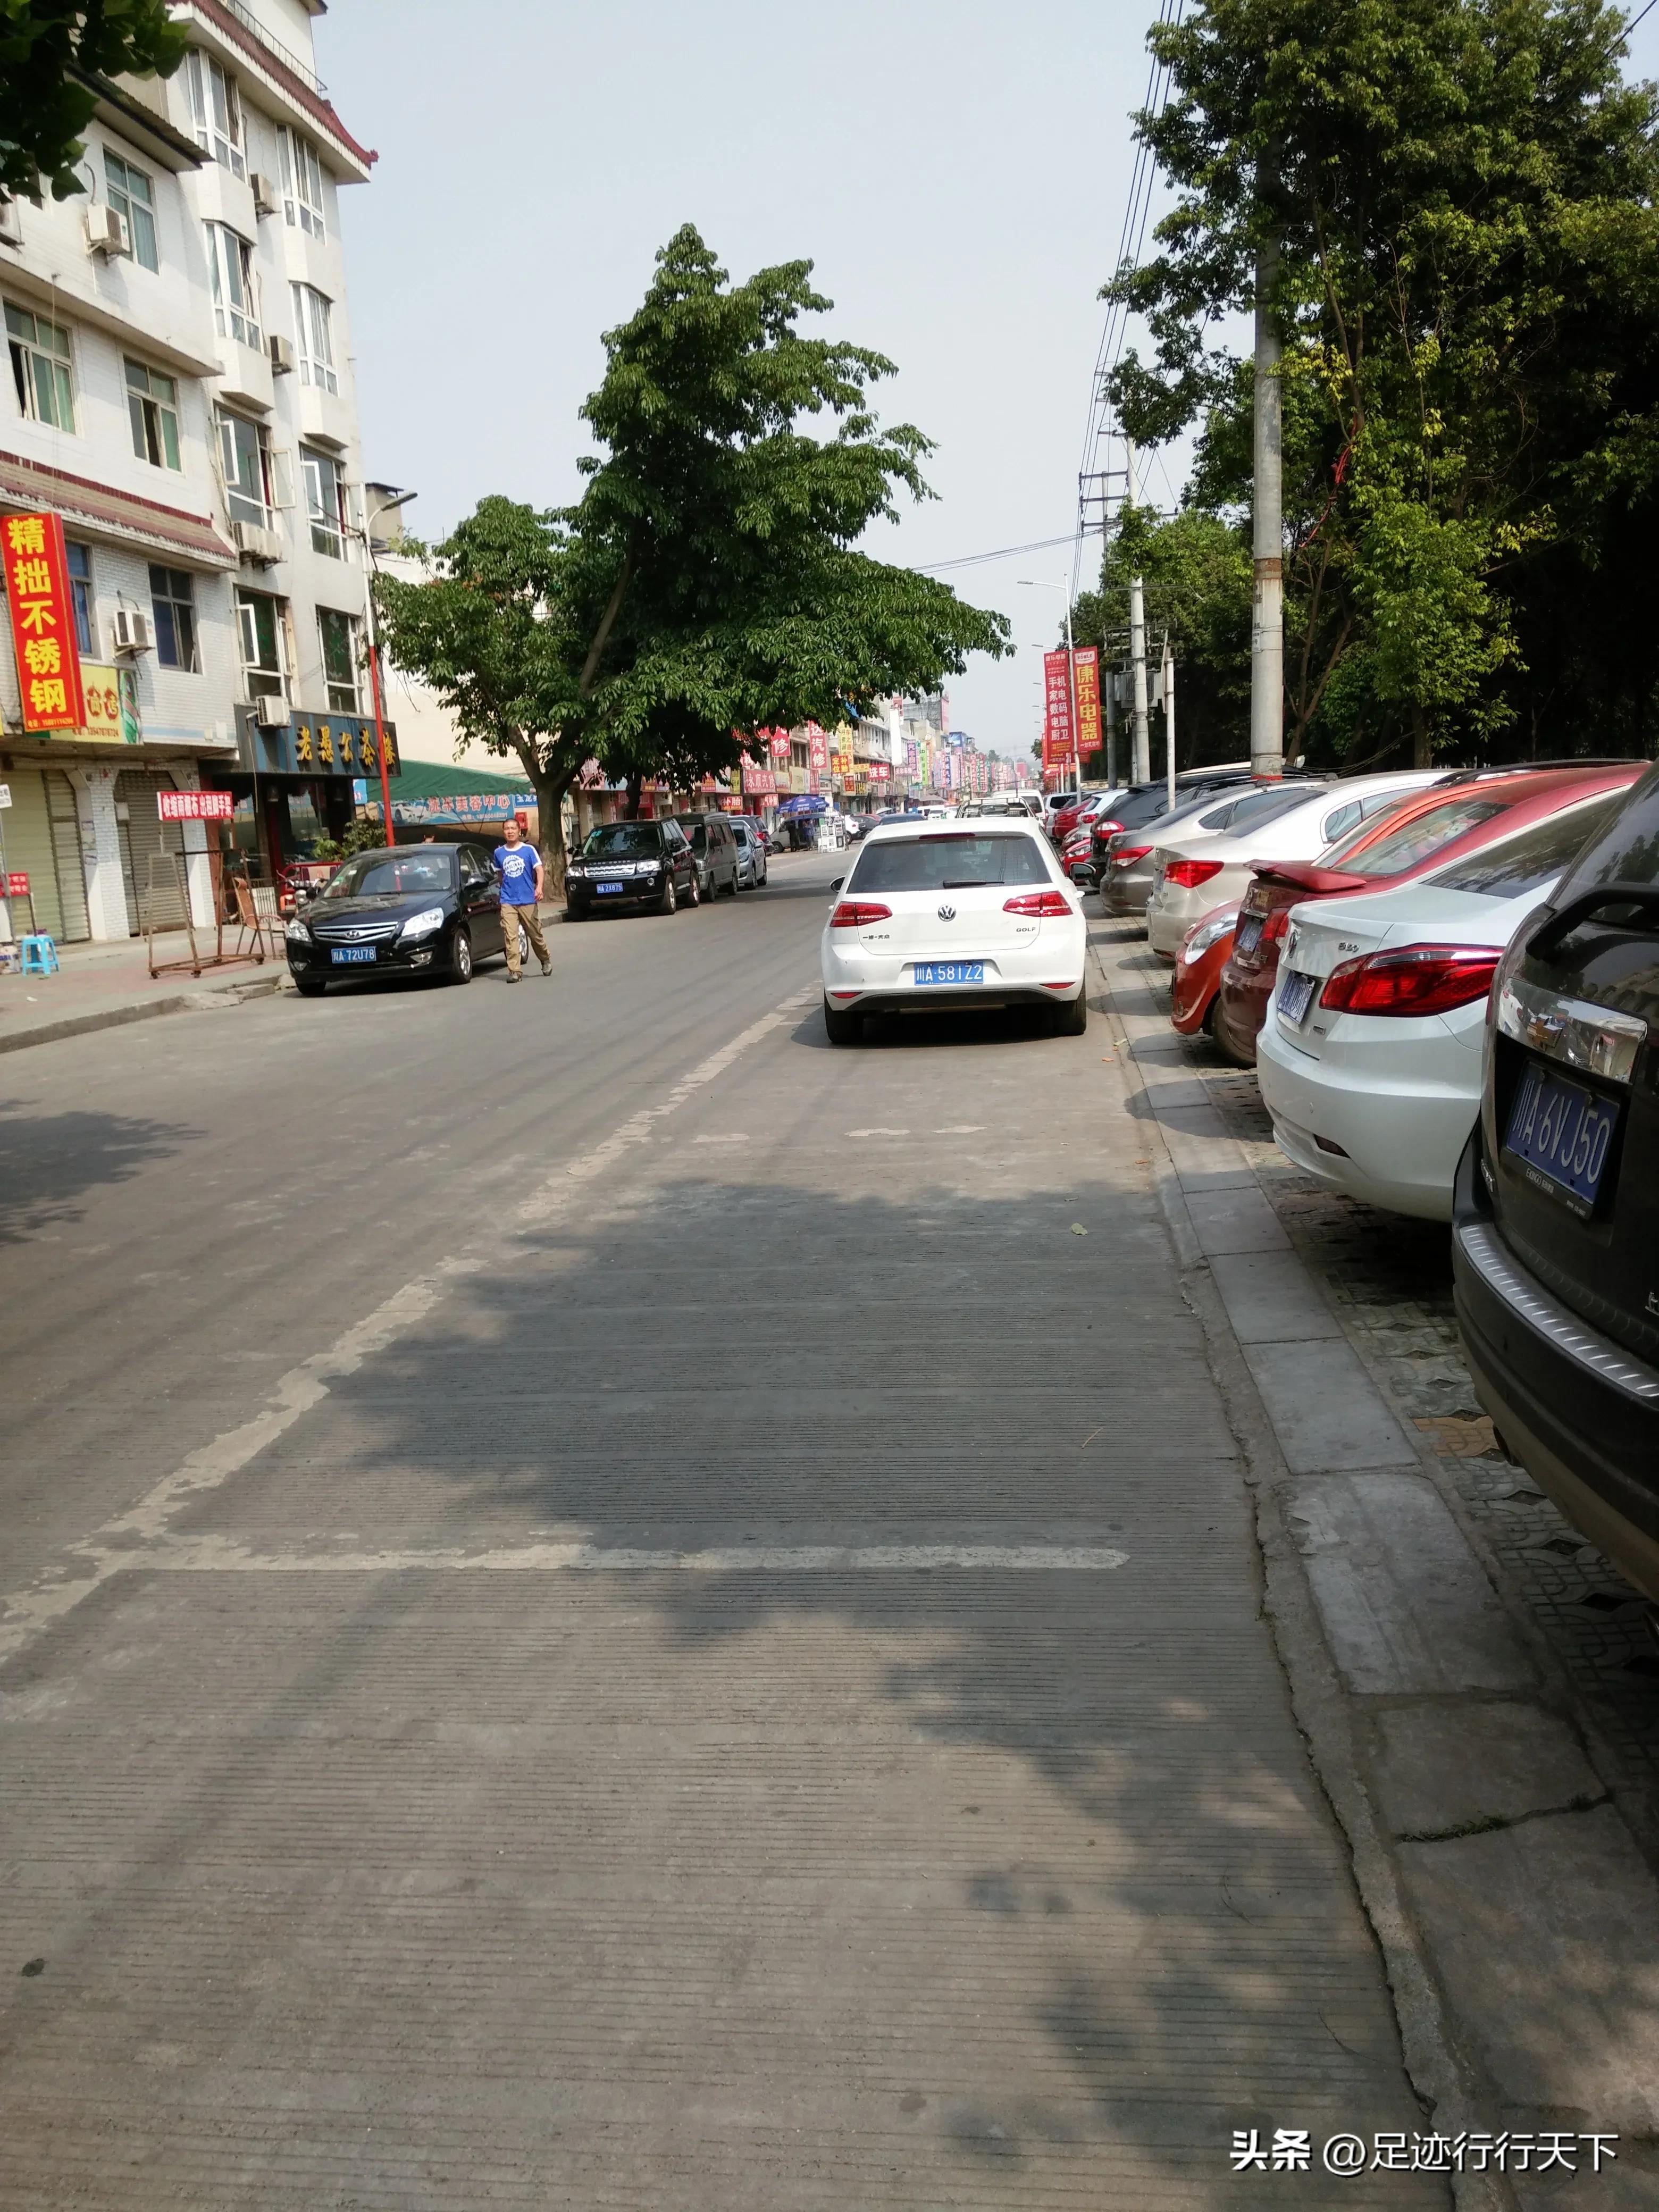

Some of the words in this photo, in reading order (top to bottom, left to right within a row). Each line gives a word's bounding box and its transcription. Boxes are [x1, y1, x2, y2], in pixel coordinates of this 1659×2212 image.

[1049, 676, 1067, 689] 手机
[1049, 689, 1067, 701] 家电
[1050, 702, 1067, 715] 数码
[1076, 665, 1097, 740] 康乐电器
[1051, 716, 1068, 727] 电脑
[1051, 729, 1069, 741] 厨卫
[869, 767, 888, 778] 洗车
[428, 794, 510, 813] 洗车美容中心
